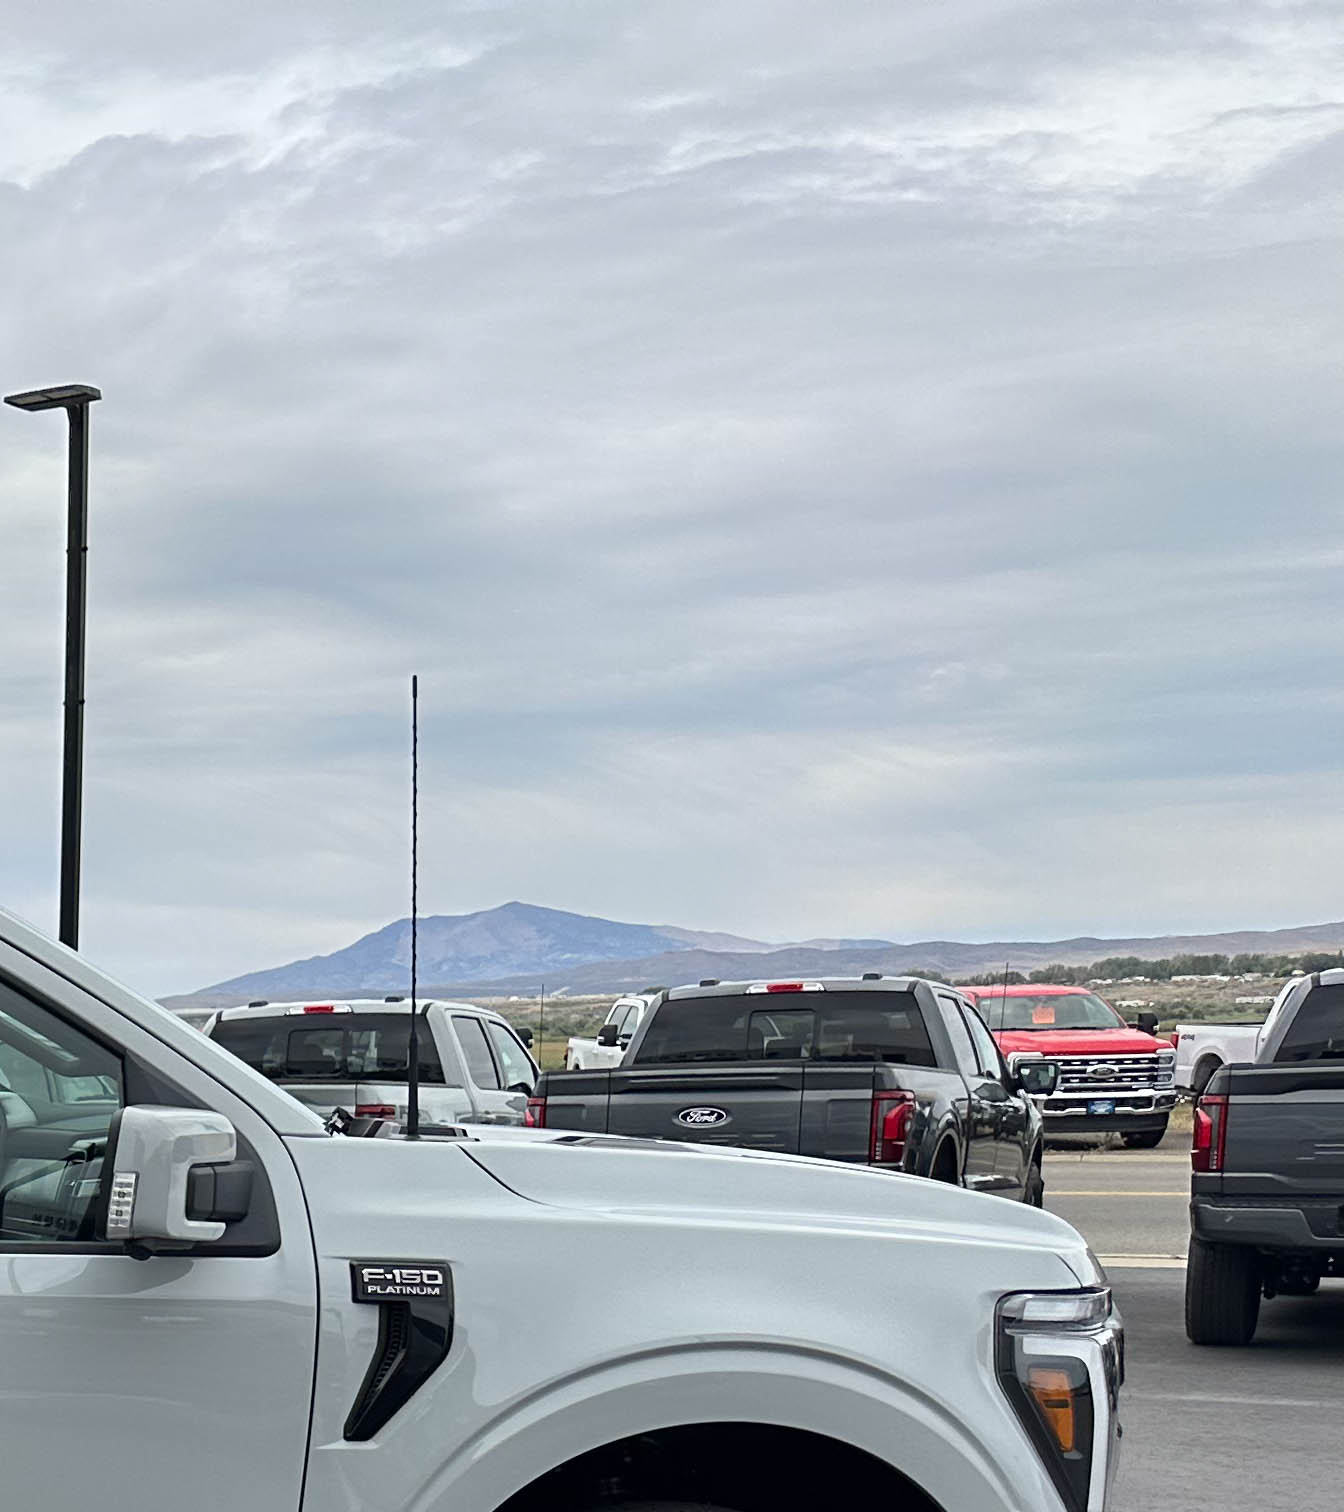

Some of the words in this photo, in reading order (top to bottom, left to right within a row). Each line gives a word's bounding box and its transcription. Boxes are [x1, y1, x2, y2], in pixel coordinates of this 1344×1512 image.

[686, 1109, 718, 1123] Ford
[361, 1268, 444, 1285] F-150
[367, 1285, 441, 1295] PLATINUM
